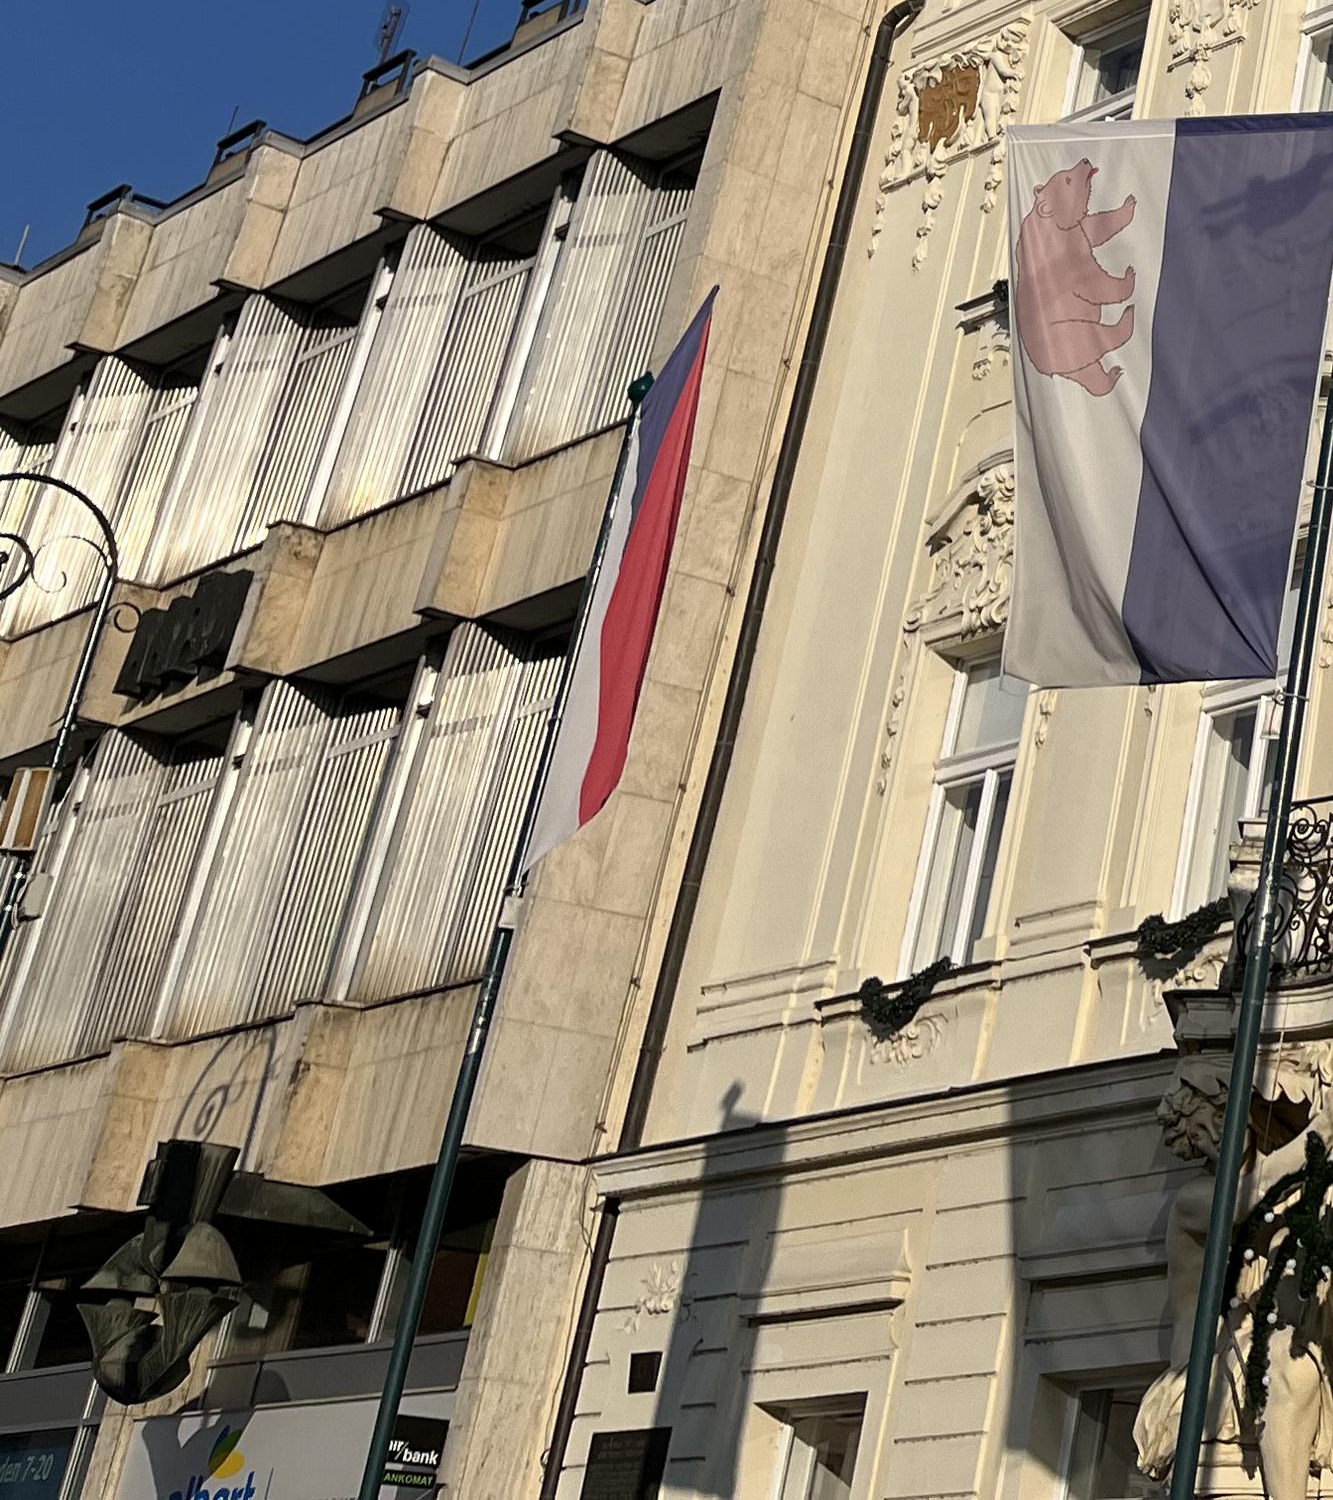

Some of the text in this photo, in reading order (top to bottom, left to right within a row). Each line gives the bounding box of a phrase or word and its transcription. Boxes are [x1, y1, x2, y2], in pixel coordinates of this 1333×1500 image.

[402, 1448, 439, 1465] bank
[22, 1453, 54, 1481] 7-20
[383, 1473, 434, 1486] ANKOMAT
